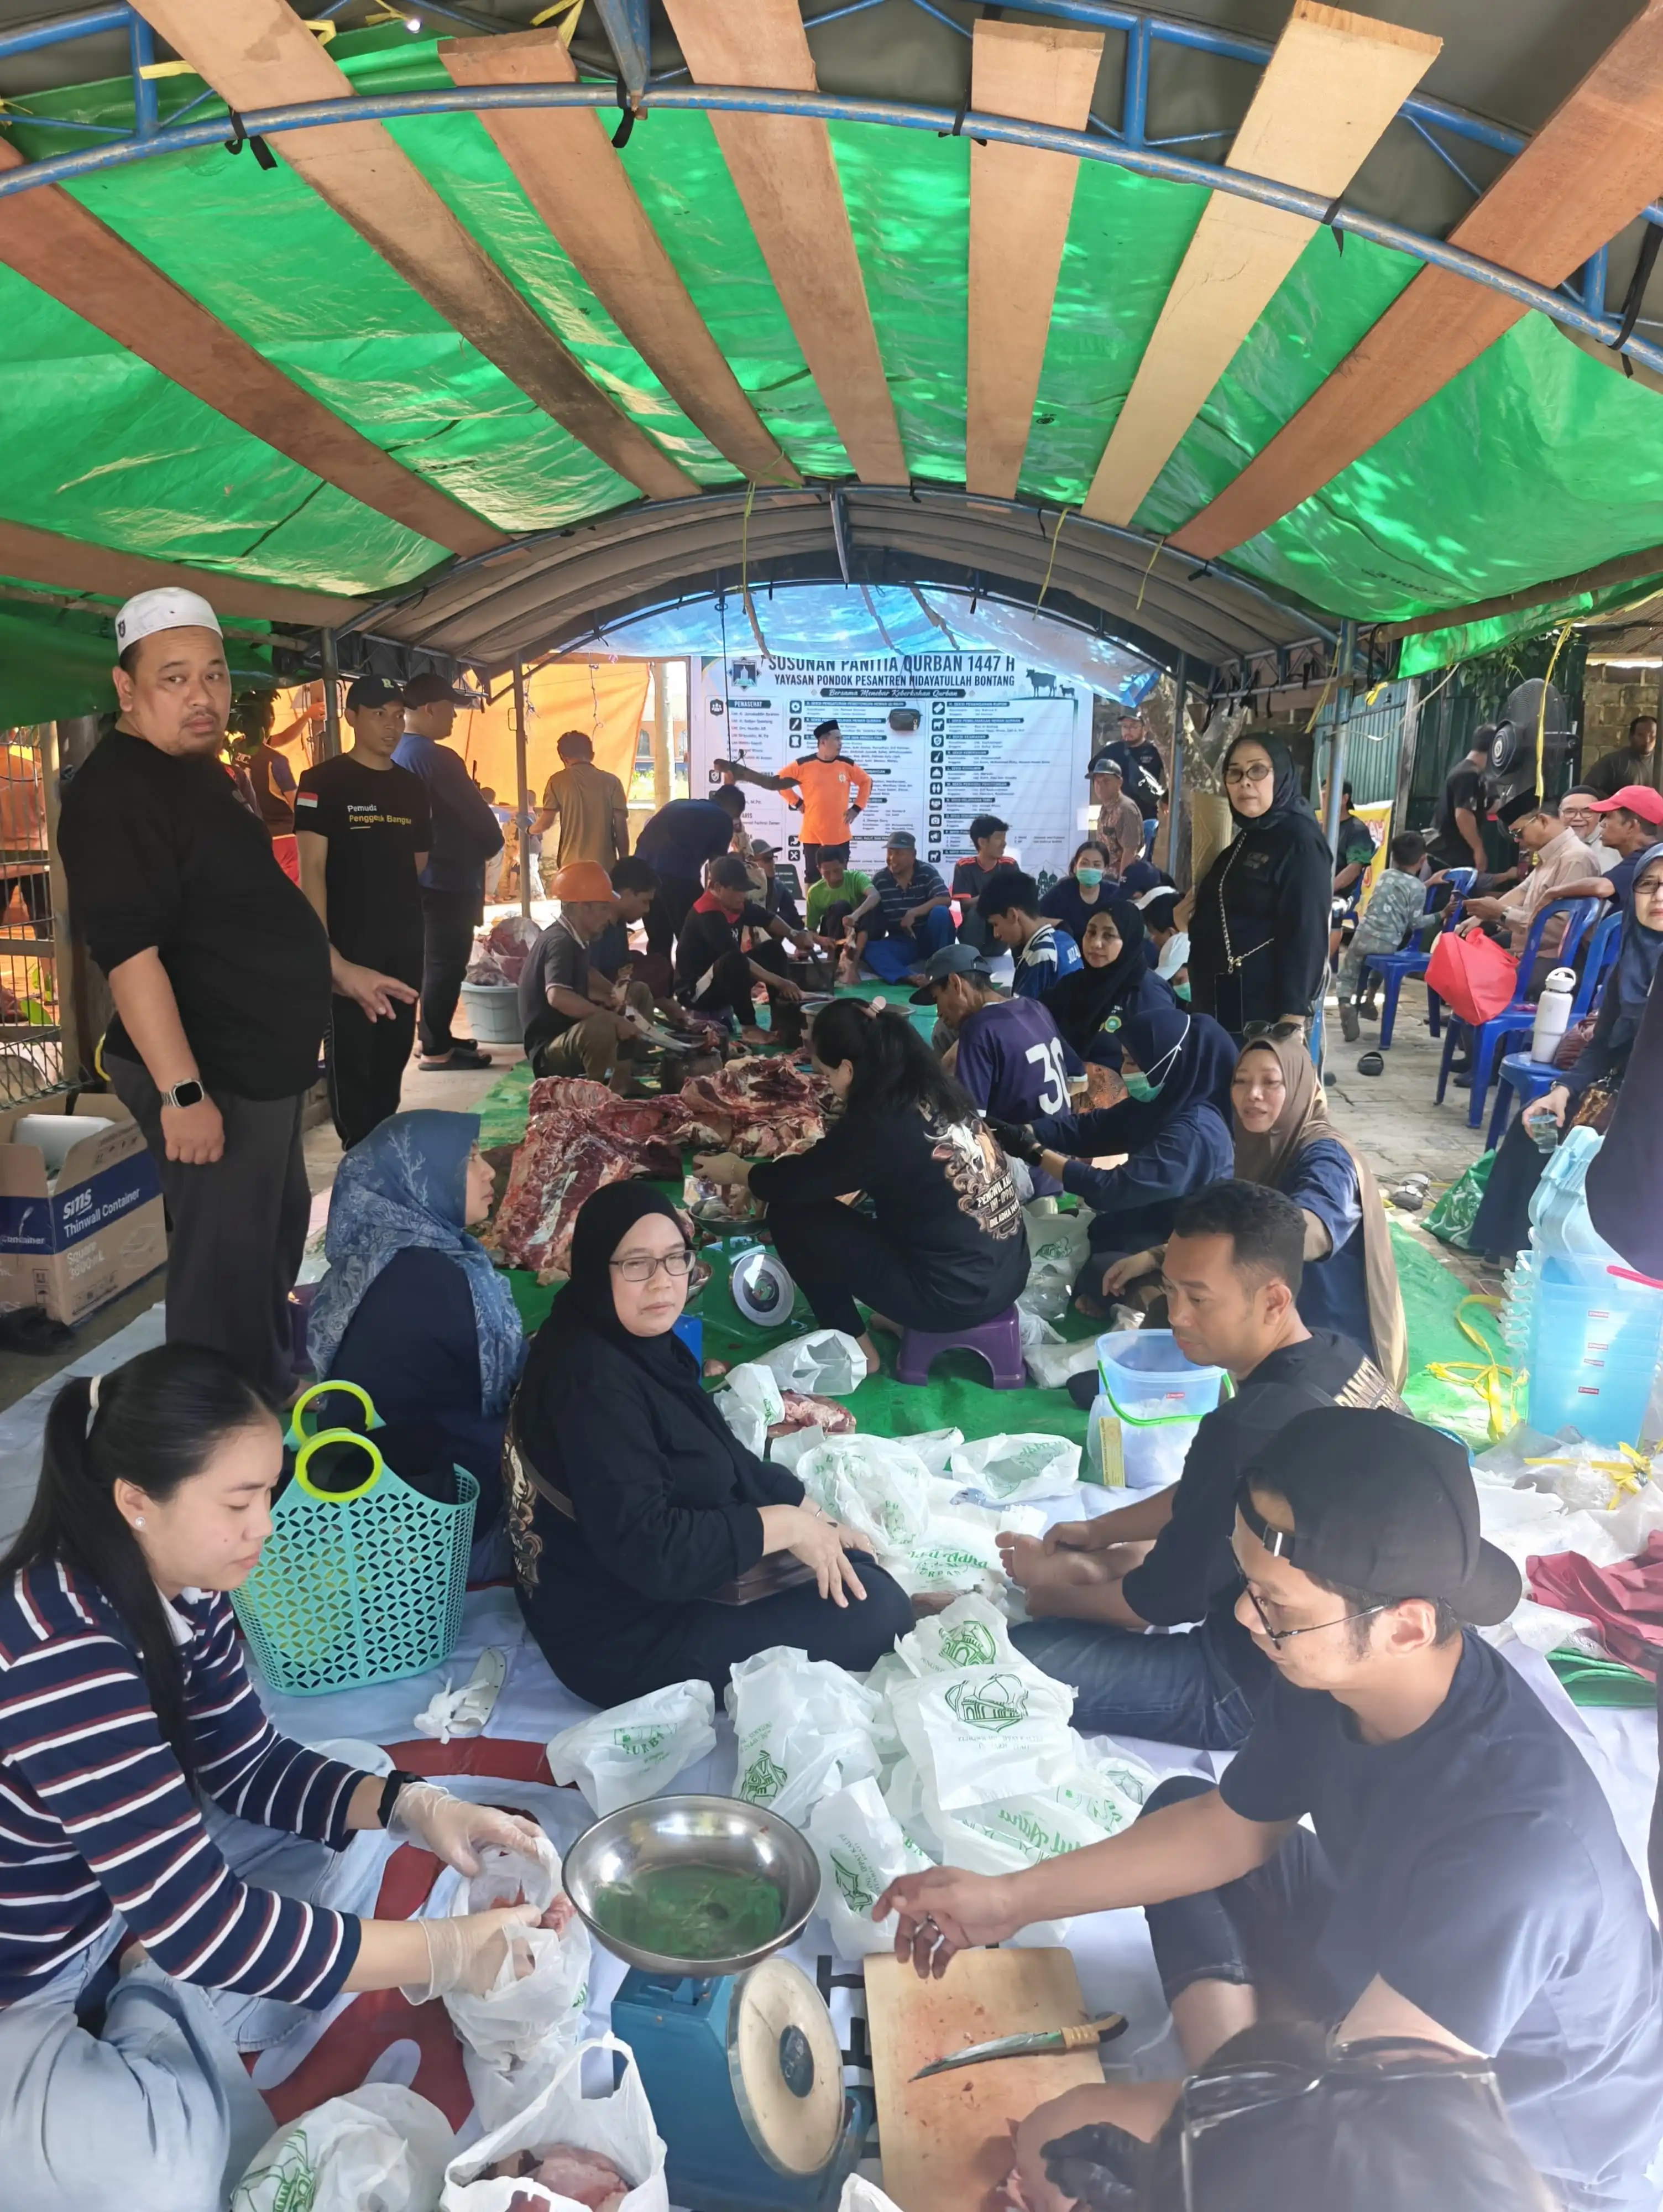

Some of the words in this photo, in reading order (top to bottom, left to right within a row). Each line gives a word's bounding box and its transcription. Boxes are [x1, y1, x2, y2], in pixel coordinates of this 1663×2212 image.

[904, 655, 963, 673] QURBAN
[968, 655, 1001, 672] 1447
[1006, 655, 1016, 672] H
[774, 674, 814, 686] YAYASAN
[817, 675, 853, 686] PONDOK
[856, 675, 906, 686] PESANTREN
[909, 675, 971, 687] HIDAYATULLAH
[975, 675, 1015, 687] BONTANG
[829, 688, 858, 697] Bersama
[860, 689, 890, 697] Menebar
[891, 689, 932, 697] Keberkahan
[933, 690, 958, 698] Qurban
[64, 1209, 101, 1239] Thinwall
[102, 1188, 140, 1217] Container
